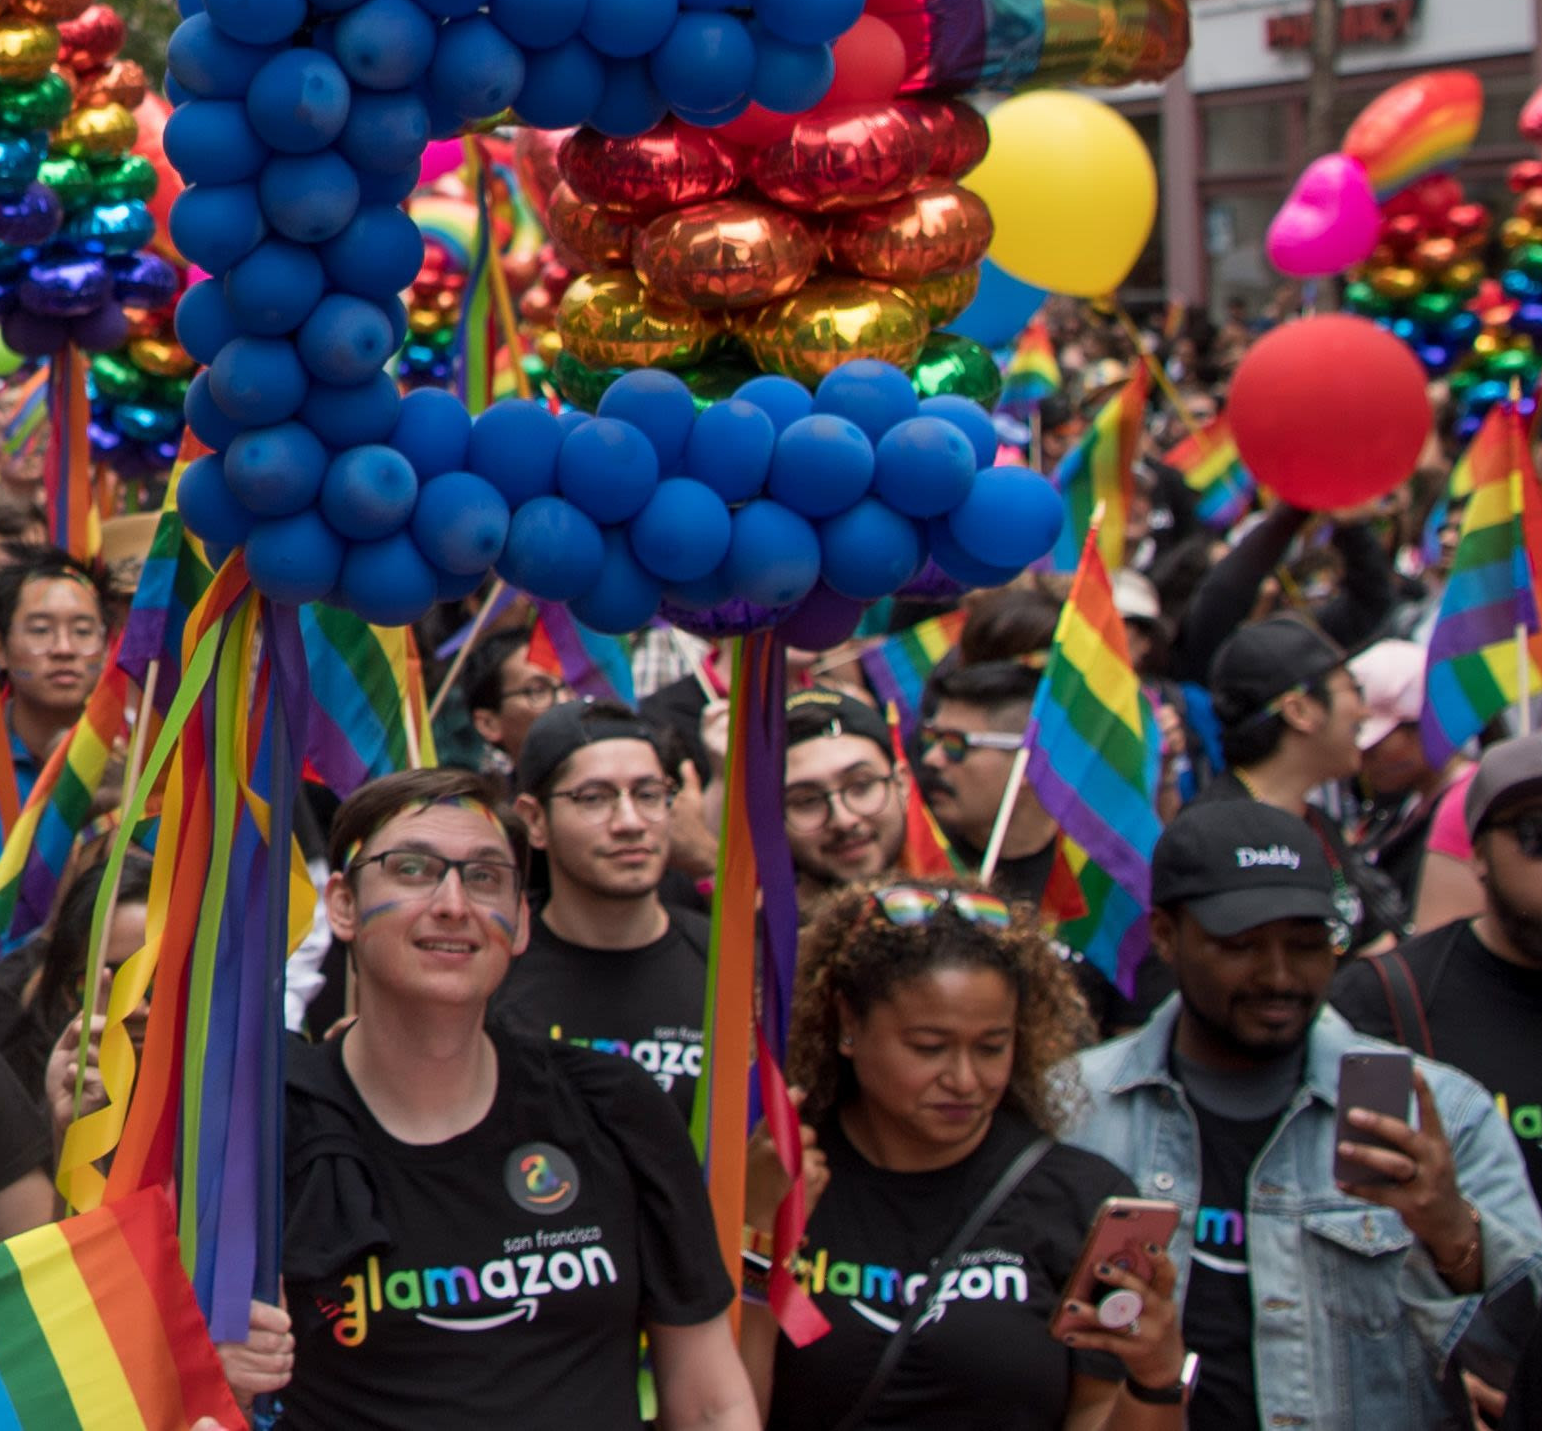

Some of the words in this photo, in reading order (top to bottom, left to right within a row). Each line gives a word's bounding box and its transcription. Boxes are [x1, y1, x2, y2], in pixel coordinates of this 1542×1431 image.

[1235, 844, 1301, 870] Daddy
[503, 1237, 533, 1254] san
[536, 1225, 602, 1249] francisco
[333, 1245, 618, 1348] glamazon
